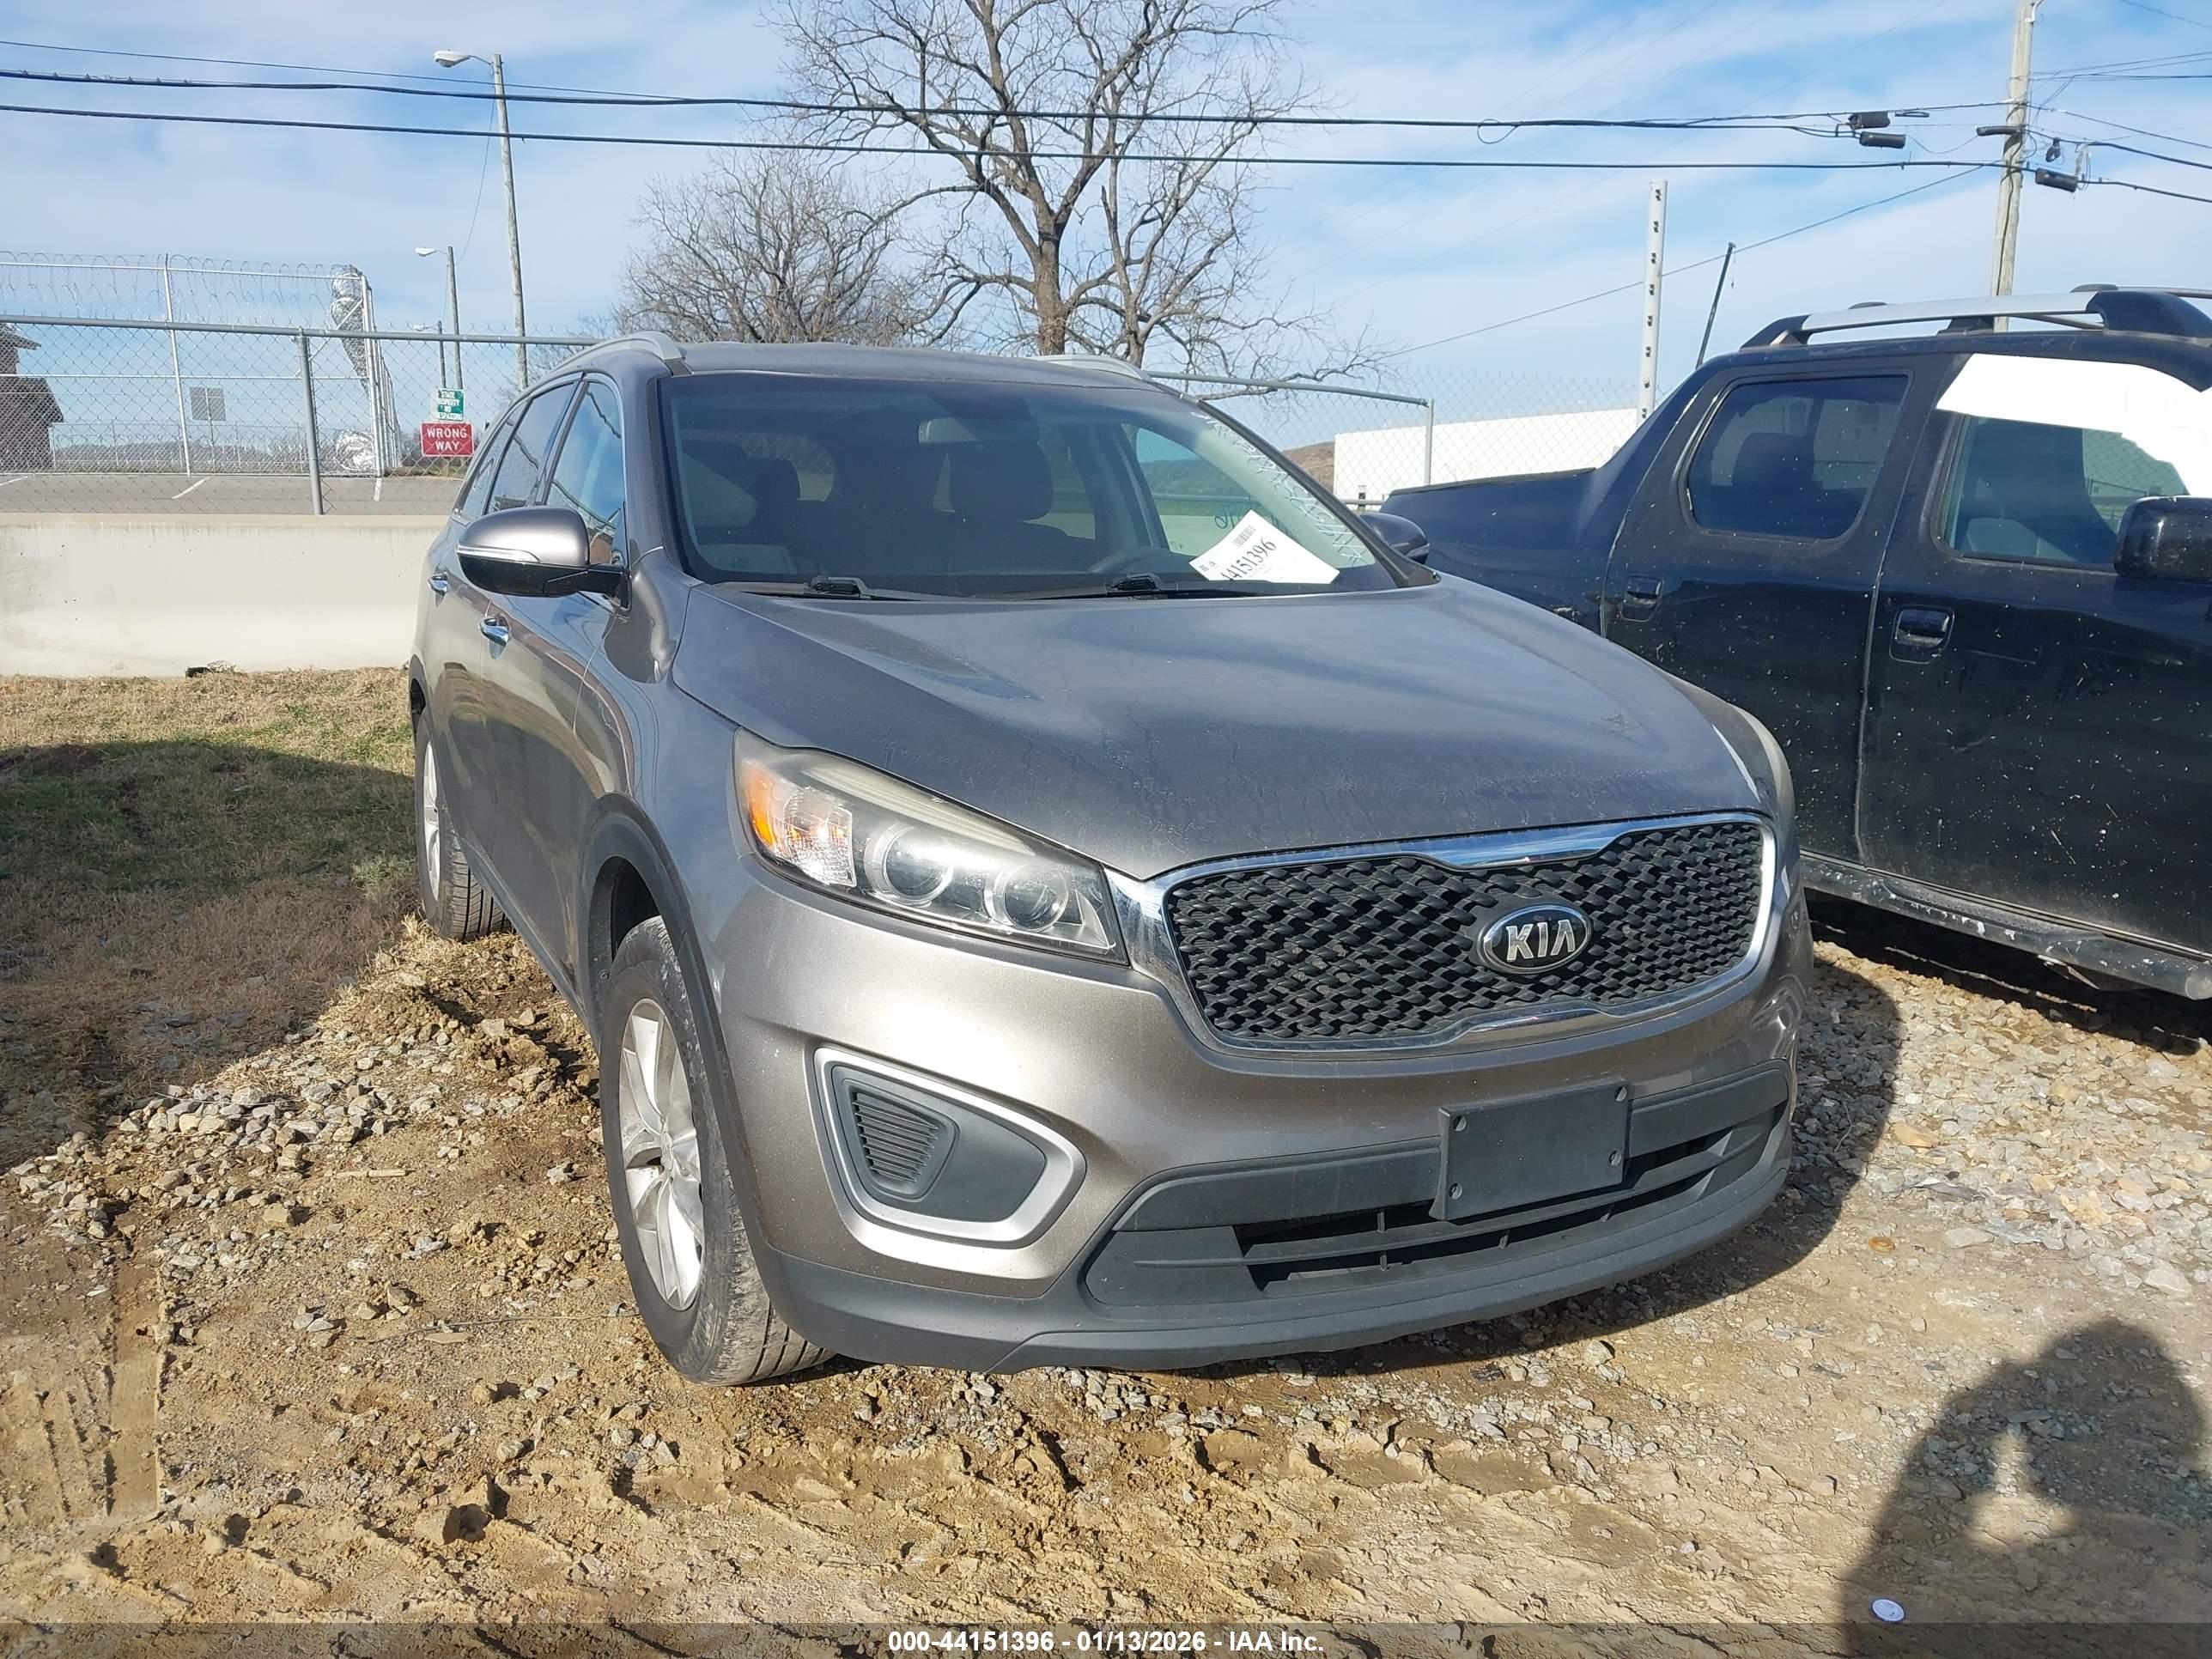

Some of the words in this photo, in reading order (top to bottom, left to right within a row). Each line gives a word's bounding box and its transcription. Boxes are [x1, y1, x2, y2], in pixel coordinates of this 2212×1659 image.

[427, 428, 467, 439] WRONG
[435, 441, 459, 451] WAY
[1505, 919, 1576, 963] KIA
